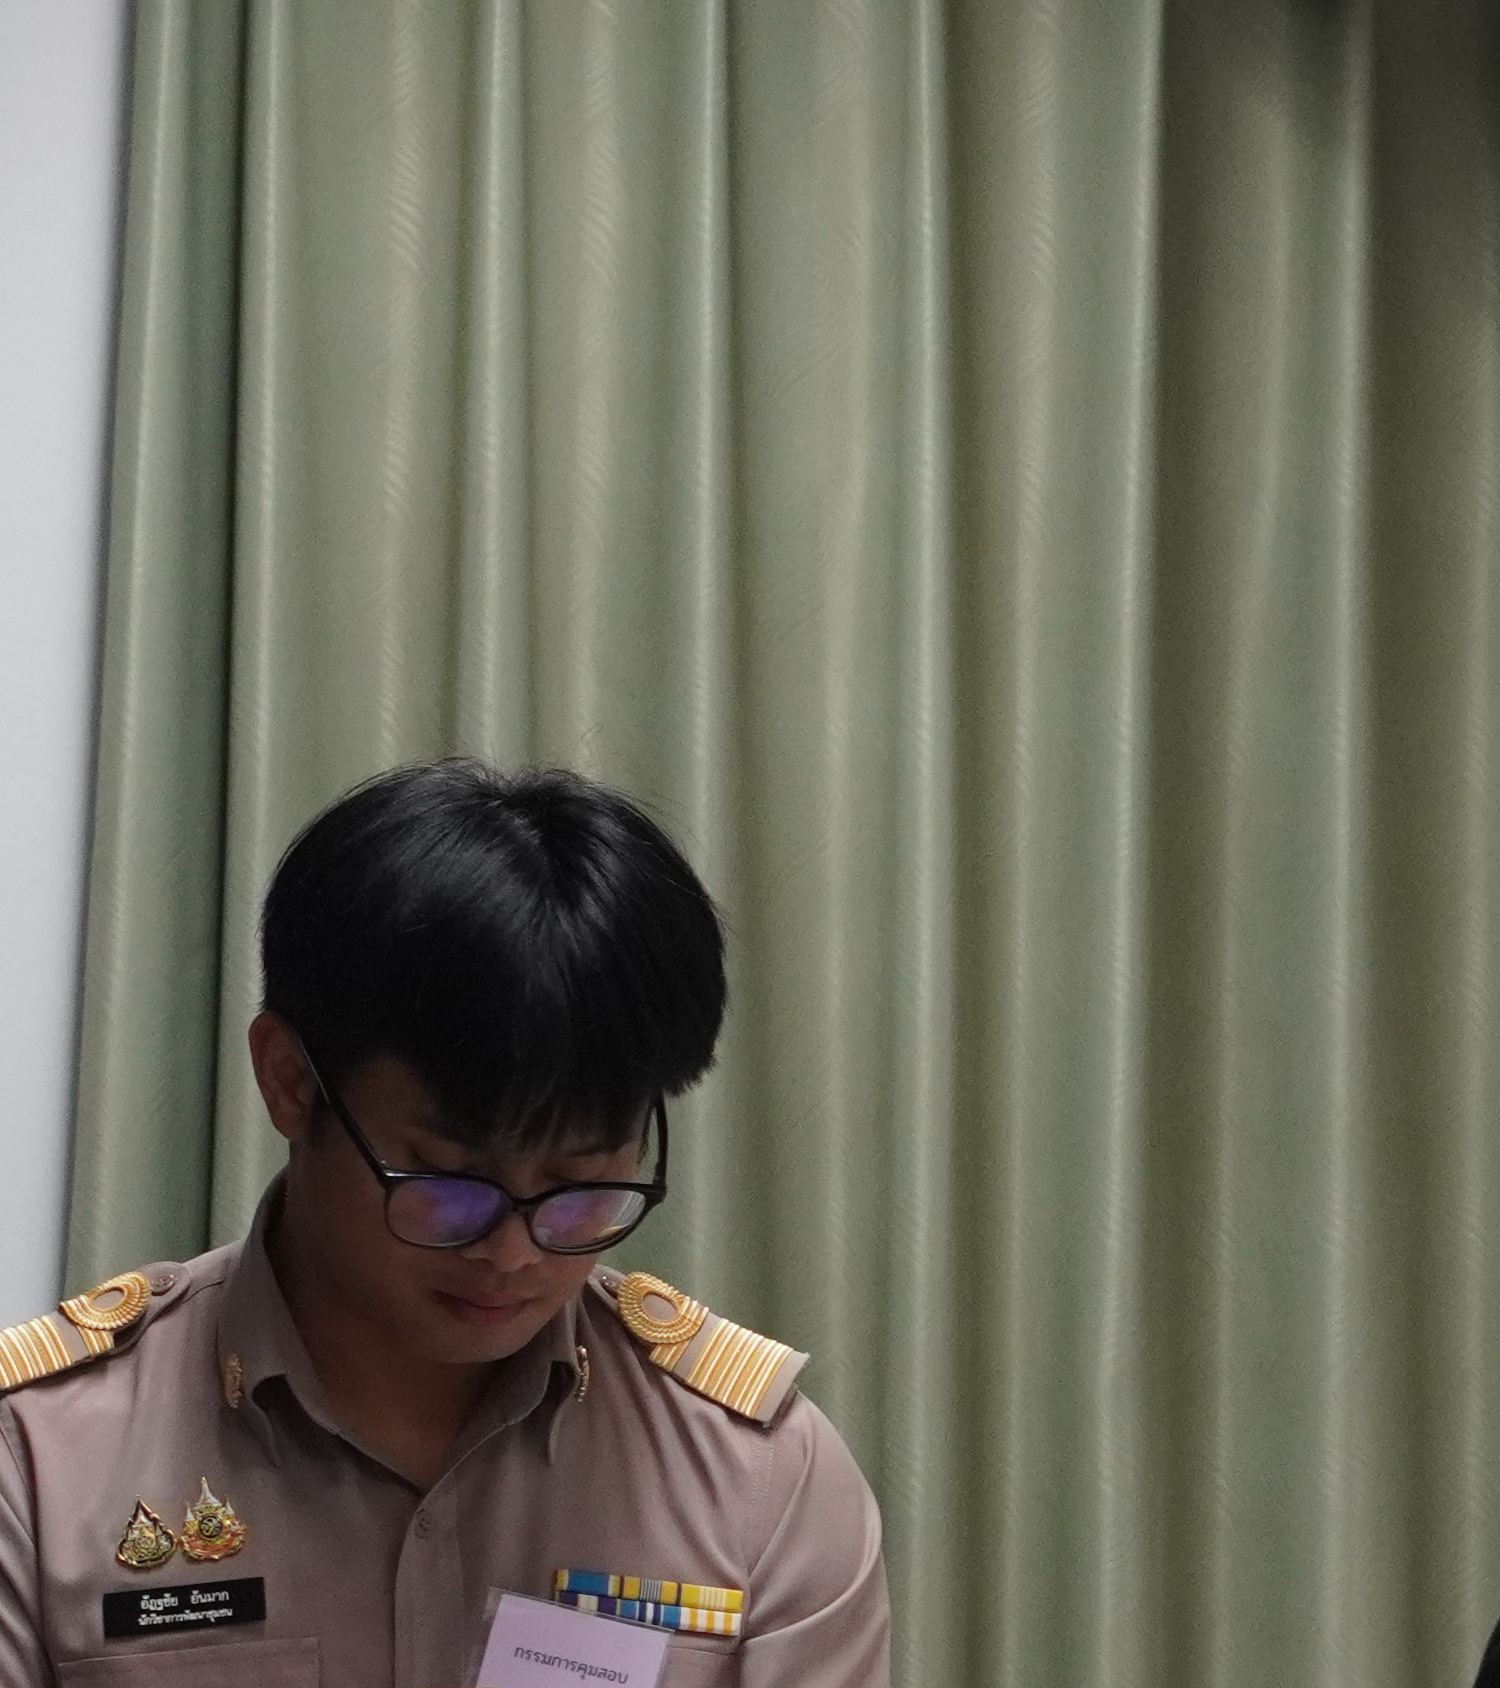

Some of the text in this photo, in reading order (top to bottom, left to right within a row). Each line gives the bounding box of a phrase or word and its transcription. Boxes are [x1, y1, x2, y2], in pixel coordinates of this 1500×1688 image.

[513, 1646, 630, 1685] กรรมการคุมสอบ
